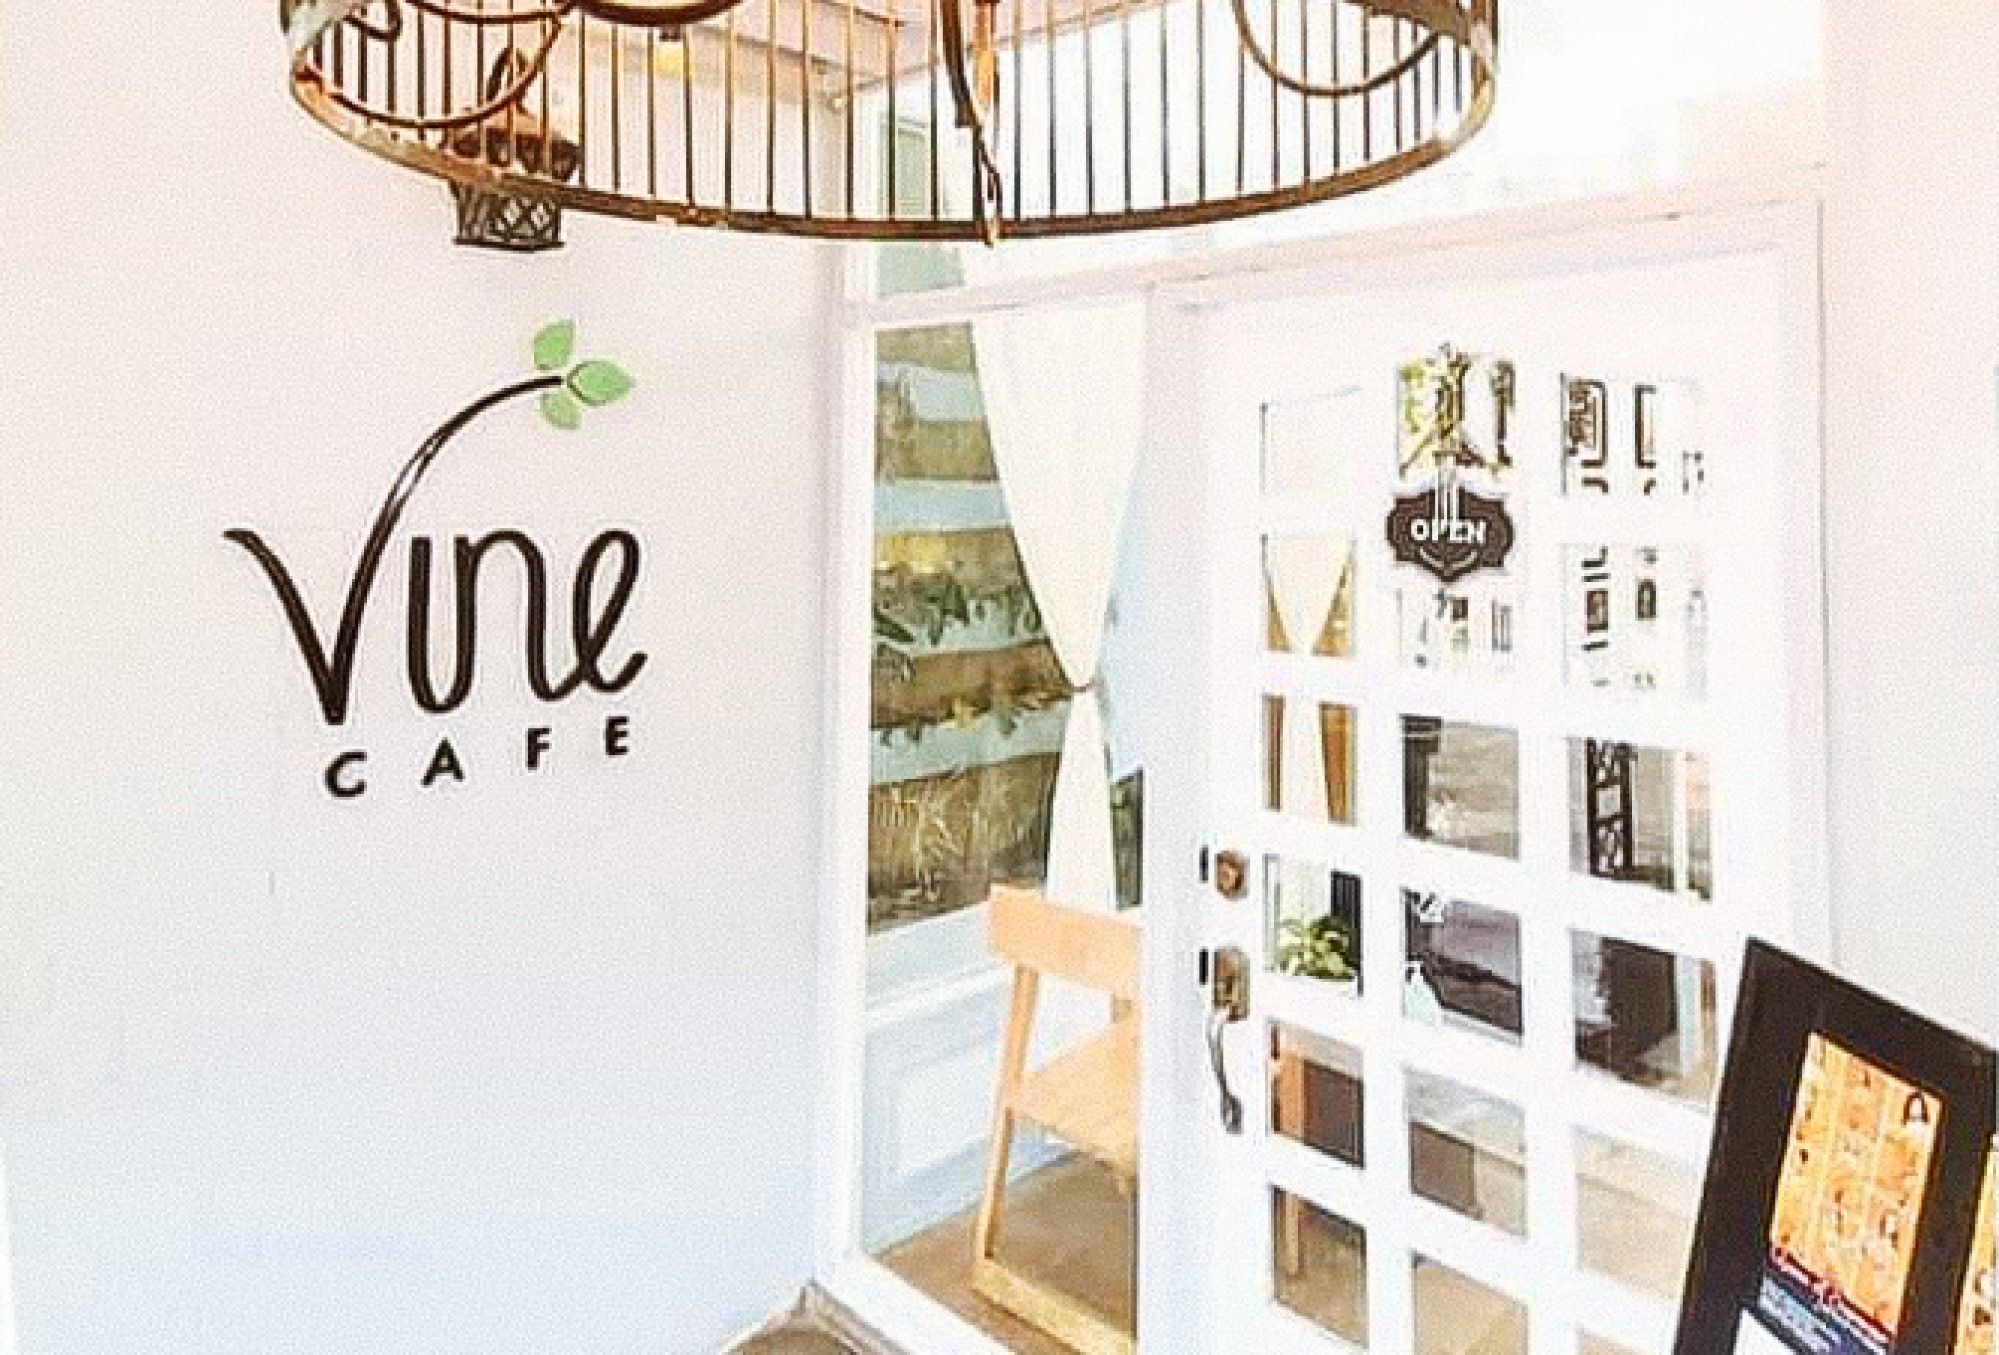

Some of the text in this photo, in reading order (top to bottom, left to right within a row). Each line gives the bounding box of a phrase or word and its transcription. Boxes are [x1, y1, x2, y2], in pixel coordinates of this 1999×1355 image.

[222, 375, 649, 726] Vine
[1410, 518, 1487, 544] OPEN
[324, 715, 631, 798] CAFE
